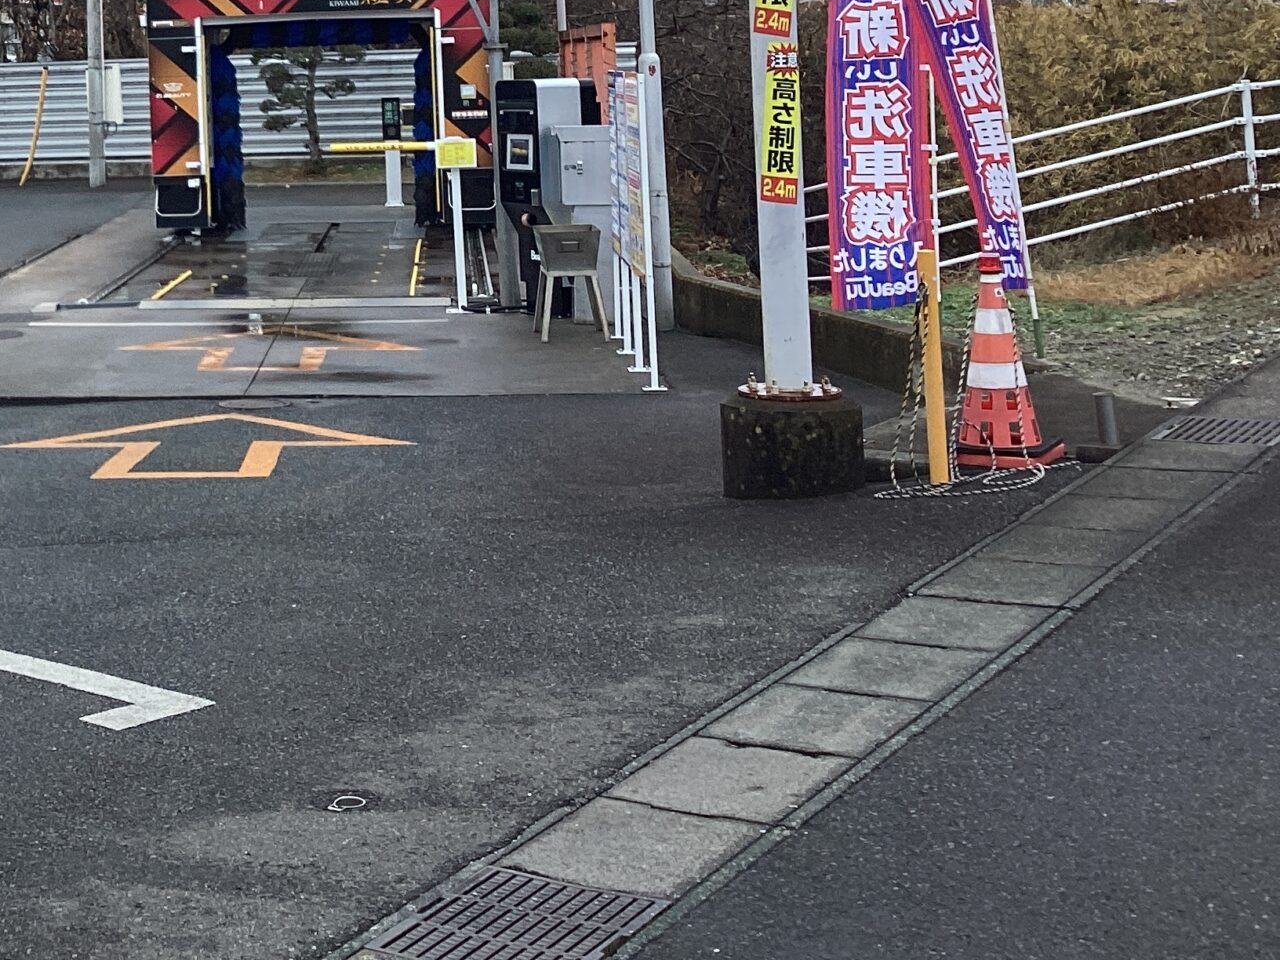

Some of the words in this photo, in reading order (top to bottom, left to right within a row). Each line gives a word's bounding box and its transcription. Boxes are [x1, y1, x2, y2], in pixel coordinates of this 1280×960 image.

[329, 0, 360, 7] KIWAMI
[756, 9, 790, 32] 2.4m
[767, 77, 797, 174] 高さ制限
[762, 178, 796, 199] 2.4m
